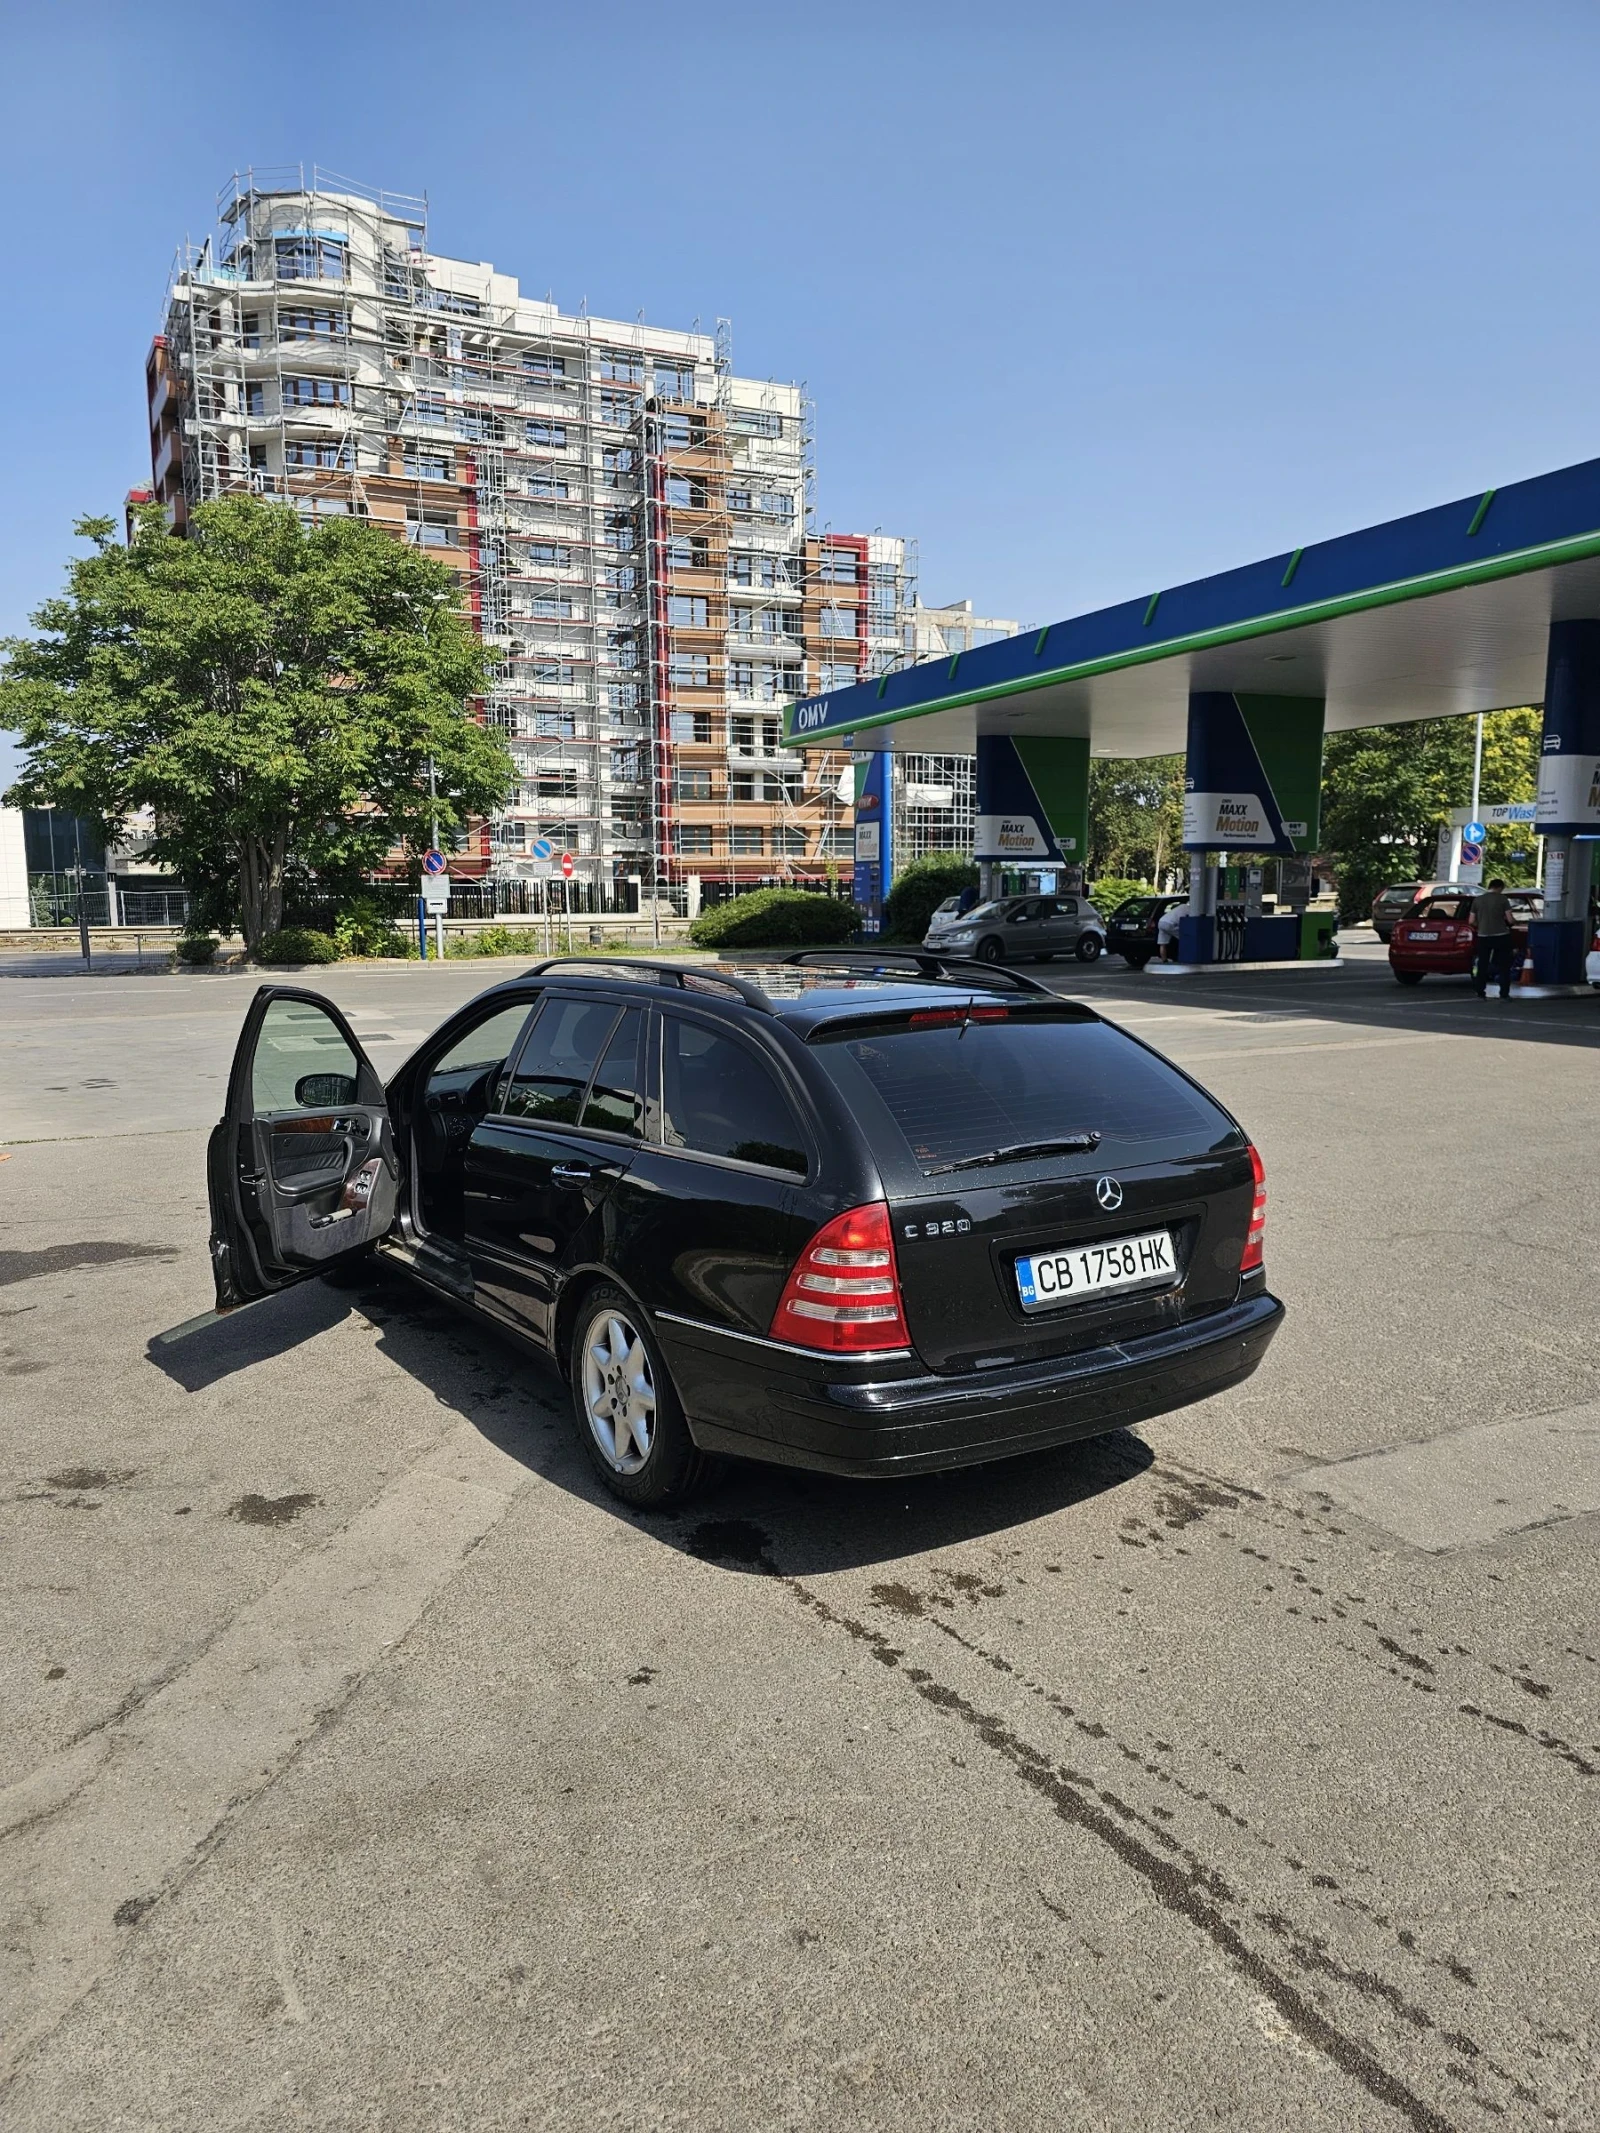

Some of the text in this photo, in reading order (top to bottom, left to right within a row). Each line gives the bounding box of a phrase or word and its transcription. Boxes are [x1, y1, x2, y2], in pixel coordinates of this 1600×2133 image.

[798, 701, 829, 730] OMV
[1219, 804, 1248, 815] MAXX
[1001, 824, 1025, 833] MAXX
[1216, 816, 1259, 832] Motion
[998, 834, 1035, 846] Motion
[904, 1224, 919, 1238] C
[1037, 1237, 1170, 1293] CB 1758 HK
[1021, 1285, 1035, 1297] BG
